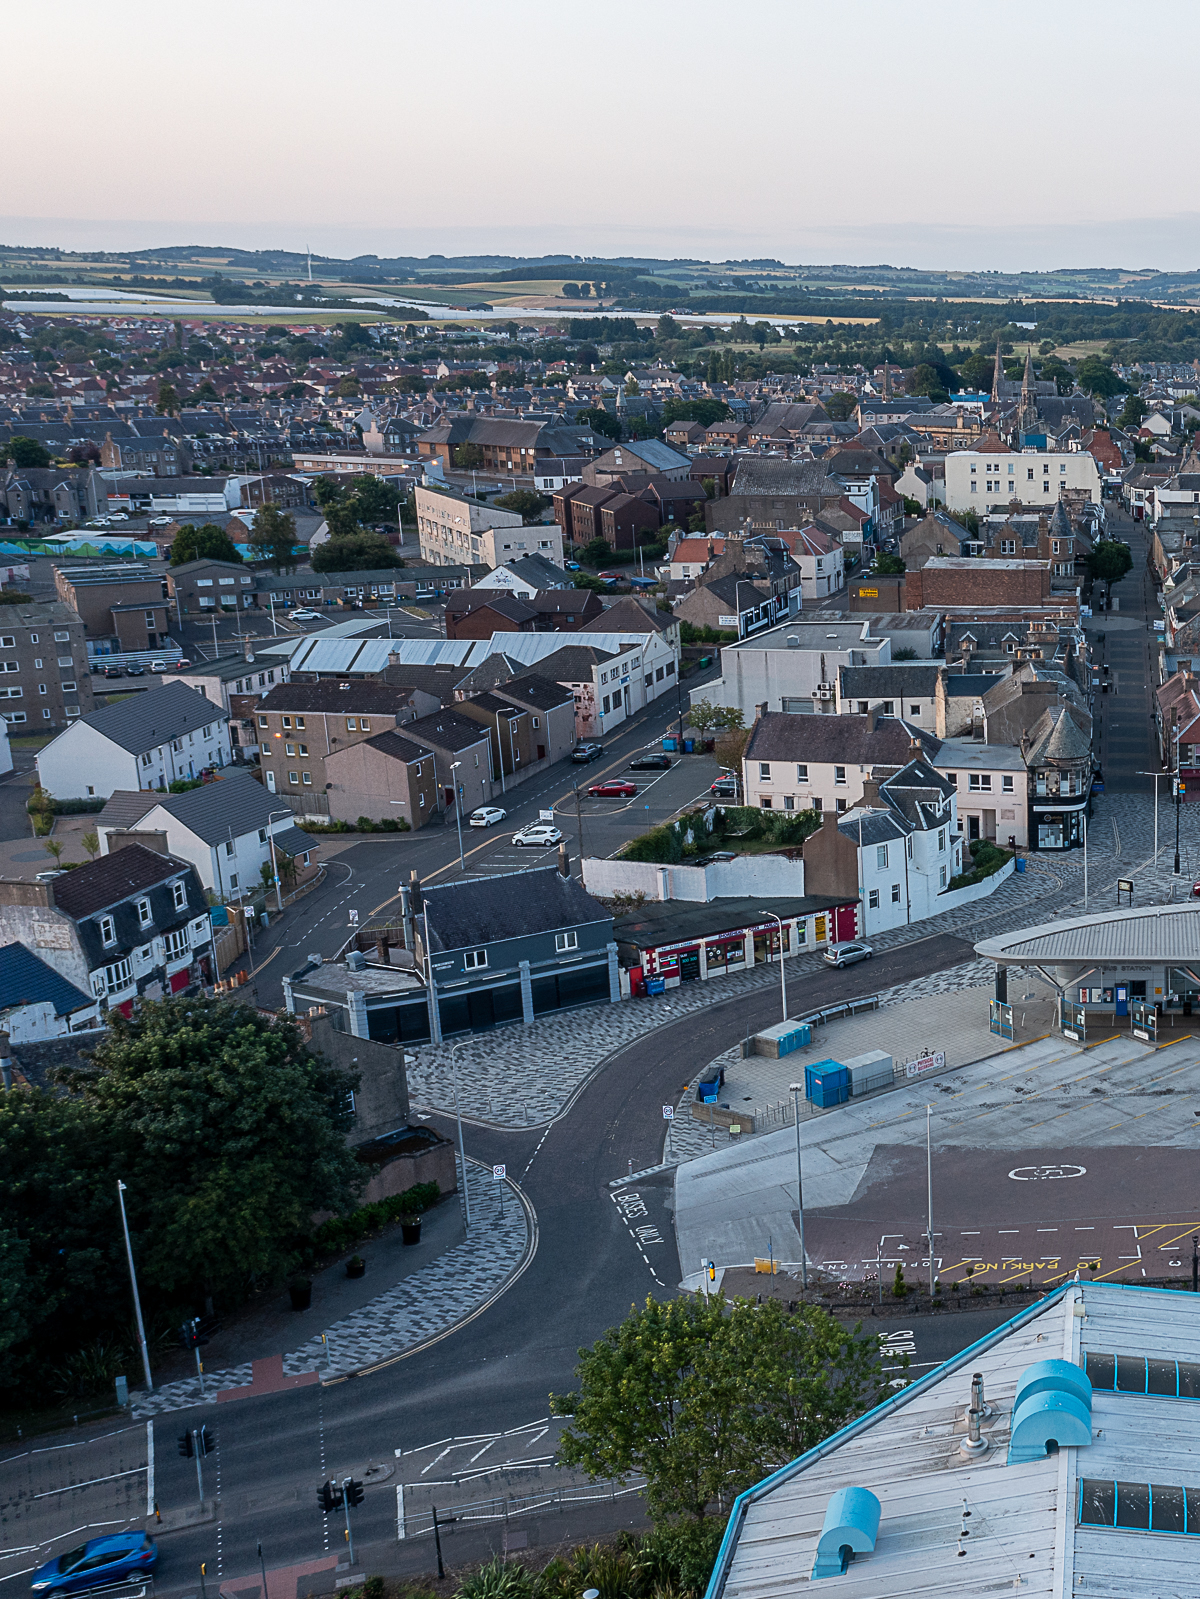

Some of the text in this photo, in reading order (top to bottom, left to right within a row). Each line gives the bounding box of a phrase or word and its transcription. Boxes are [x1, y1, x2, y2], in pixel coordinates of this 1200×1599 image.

[617, 1193, 648, 1218] BUSES
[635, 1224, 665, 1244] ONLY
[974, 1261, 1059, 1270] PARKING
